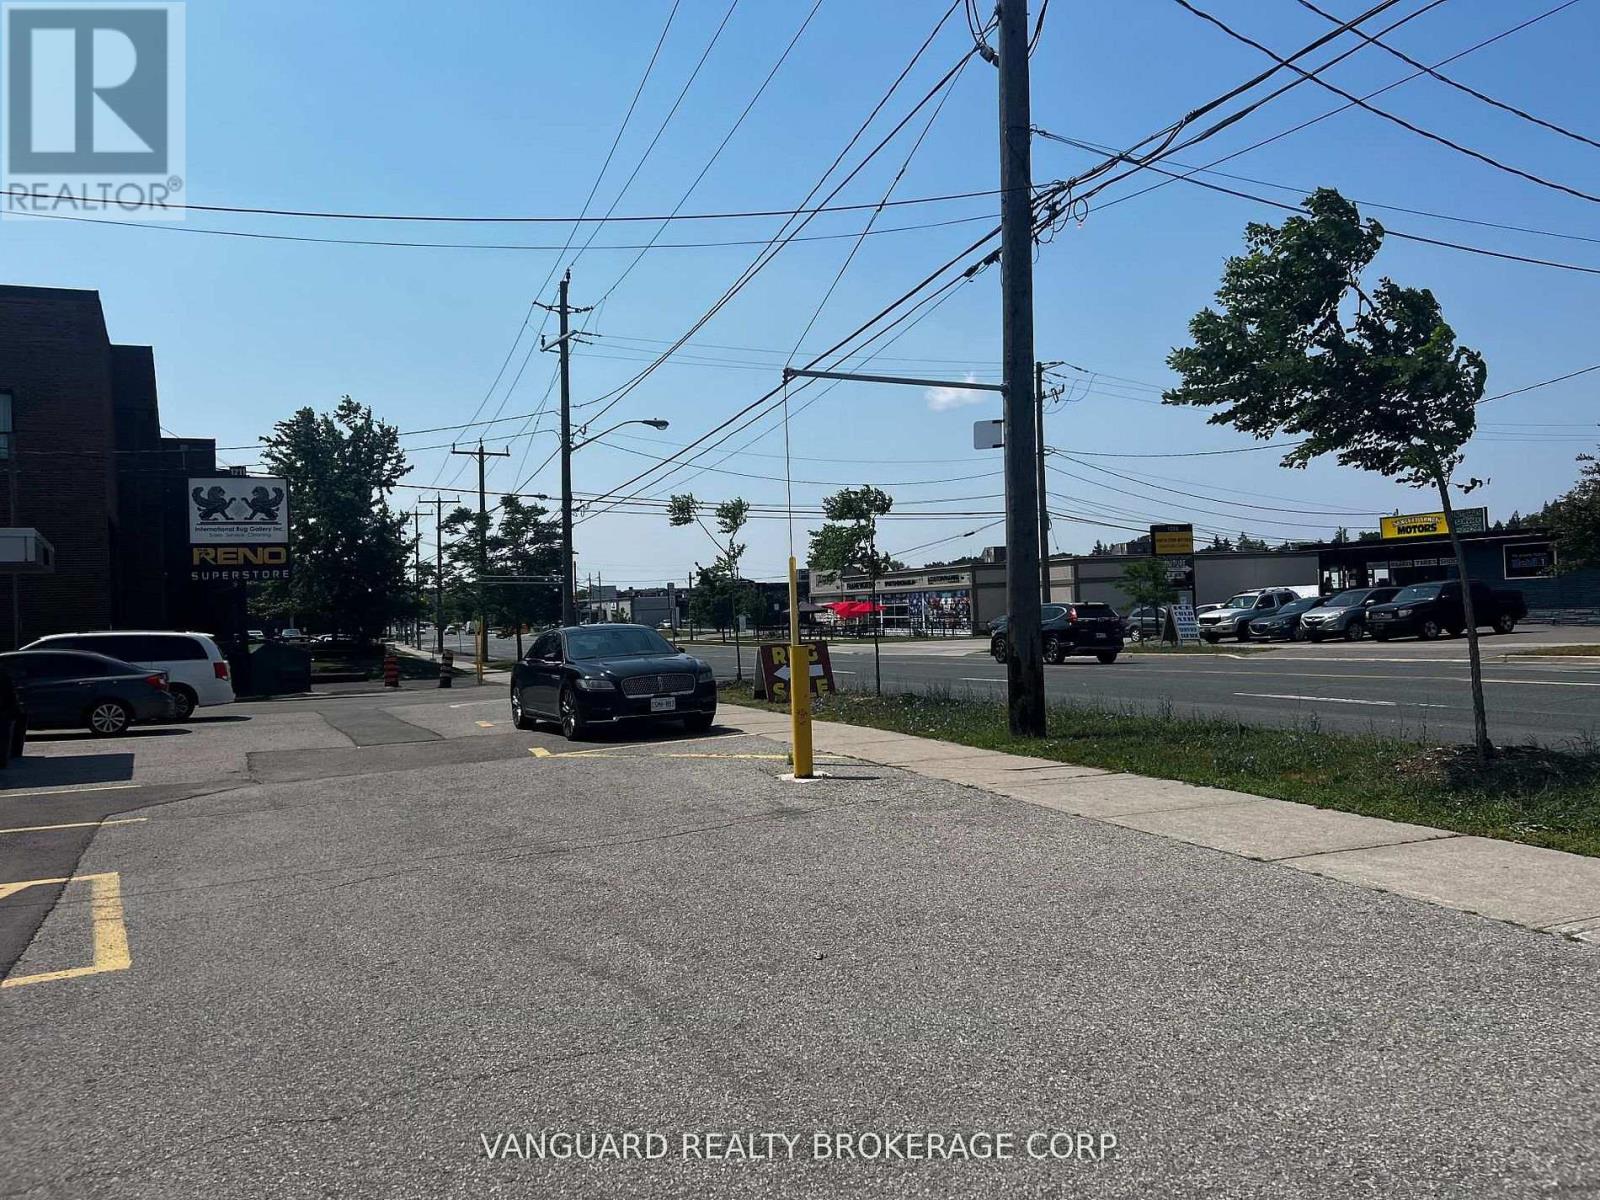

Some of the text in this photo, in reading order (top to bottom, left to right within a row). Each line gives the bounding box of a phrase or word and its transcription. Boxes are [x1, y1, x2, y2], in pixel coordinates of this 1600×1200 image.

[1398, 523, 1437, 534] MOTORS
[193, 547, 287, 565] RENO
[191, 570, 290, 581] SUPERSTORE
[772, 643, 818, 665] RG
[773, 679, 829, 701] SE
